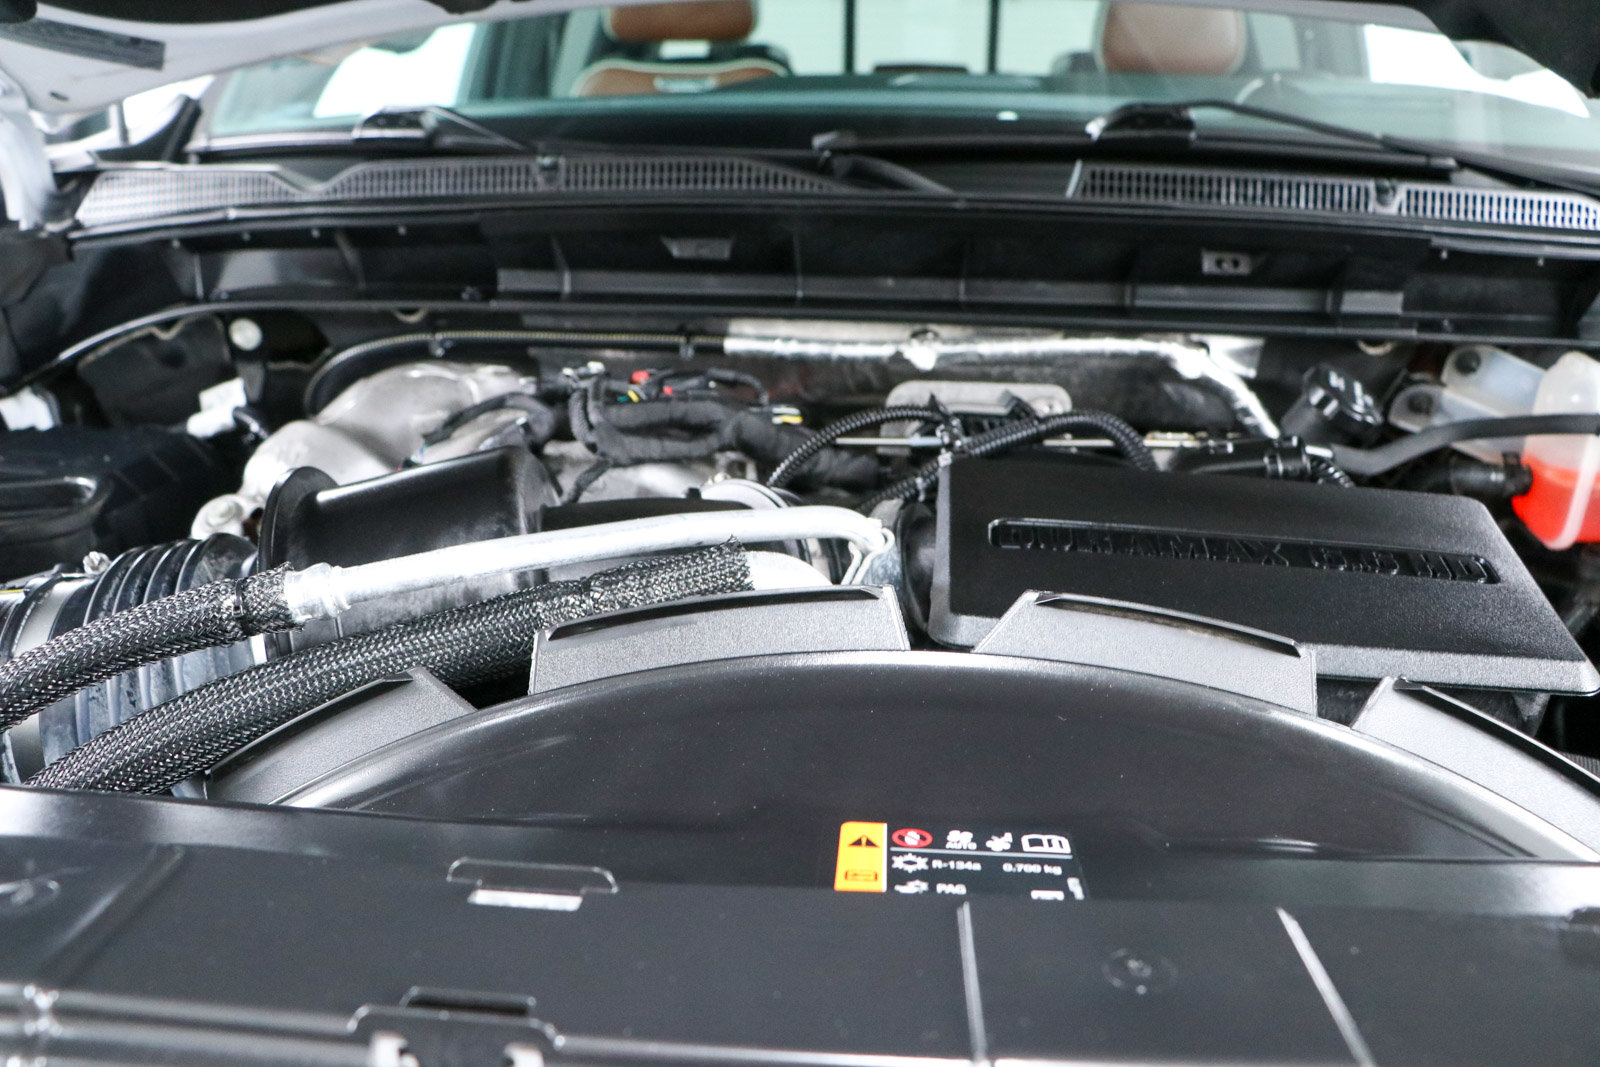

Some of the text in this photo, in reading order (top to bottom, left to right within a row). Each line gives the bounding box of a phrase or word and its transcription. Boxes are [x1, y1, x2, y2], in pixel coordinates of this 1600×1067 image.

[945, 841, 977, 850] AUTO
[931, 859, 982, 871] R-134a
[1043, 863, 1063, 876] kg
[936, 883, 967, 896] PAG
